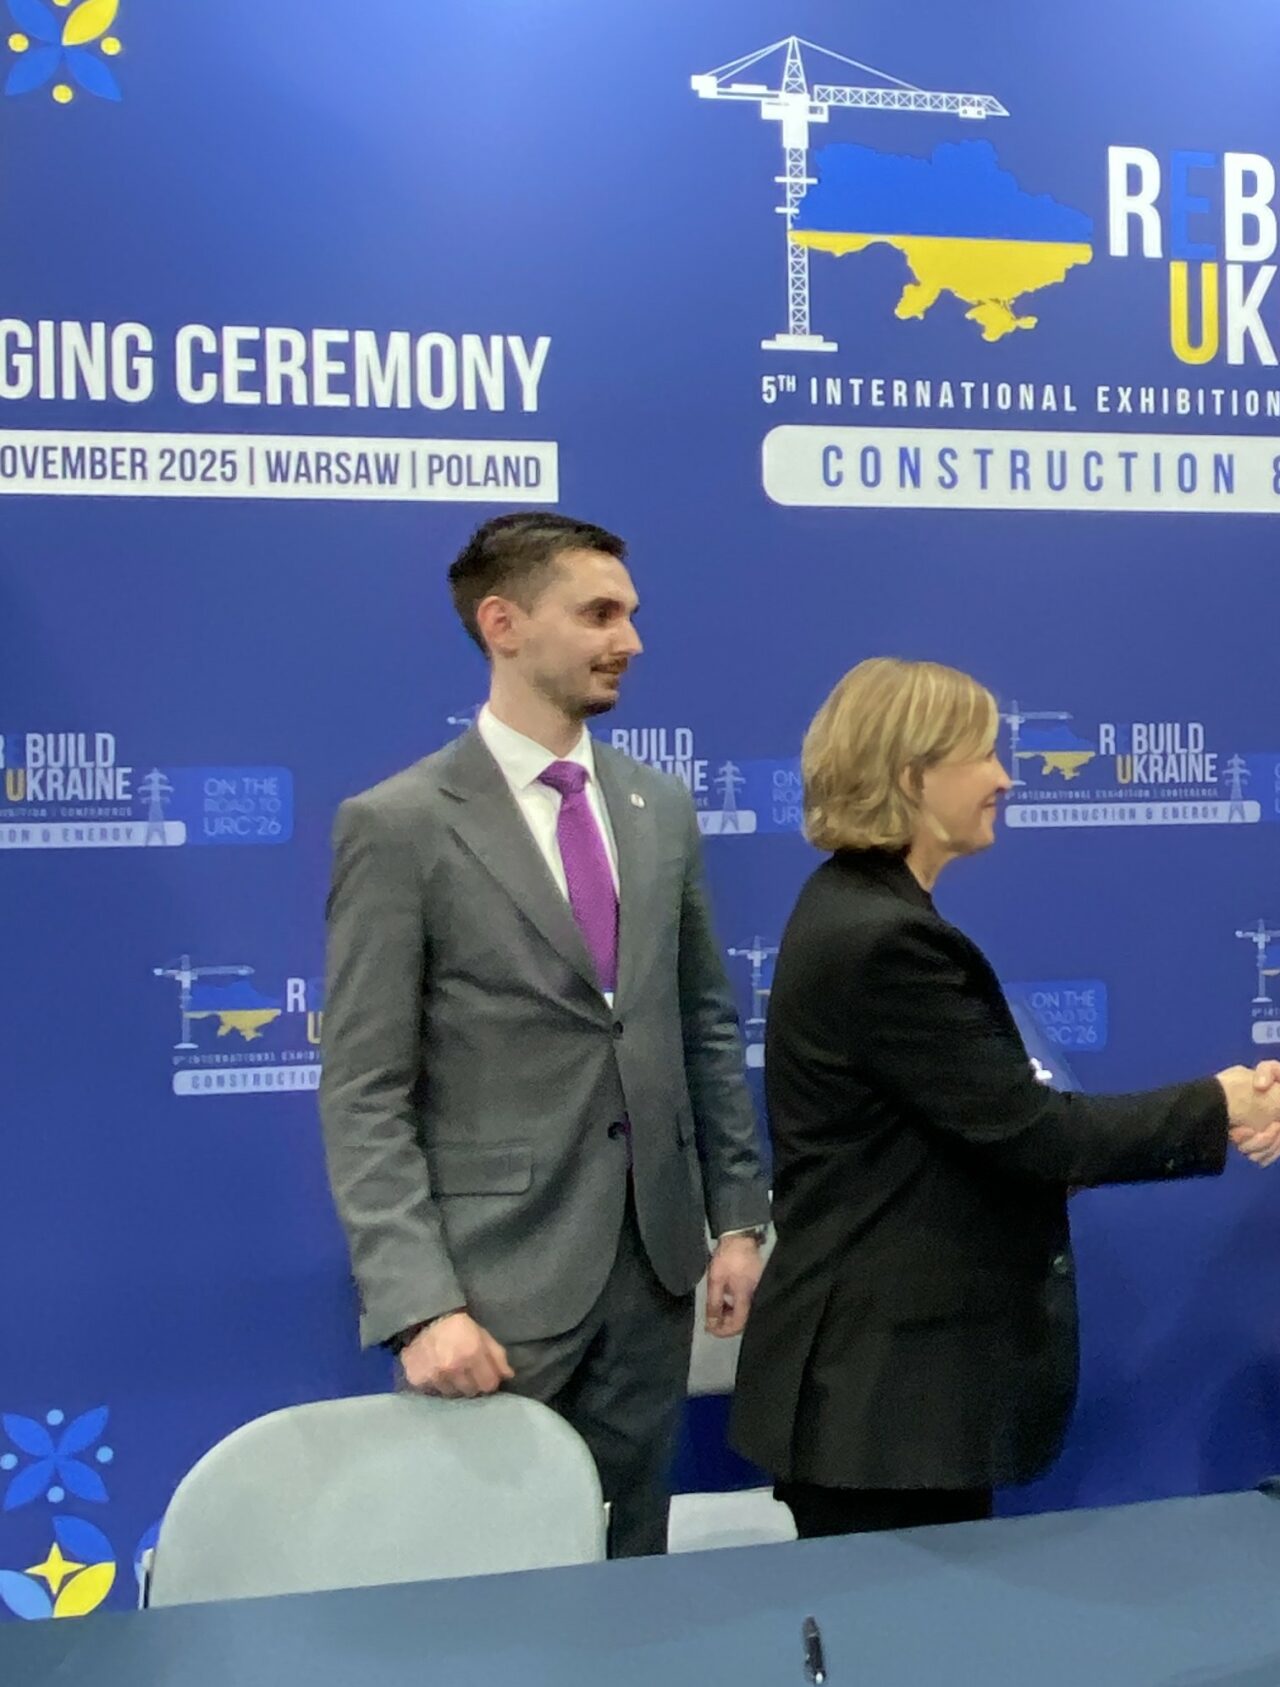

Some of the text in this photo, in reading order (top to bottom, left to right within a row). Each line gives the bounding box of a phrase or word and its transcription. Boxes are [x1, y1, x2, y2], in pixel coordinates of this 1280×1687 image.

[175, 325, 552, 413] CEREMONY
[810, 377, 1078, 412] INTERNATIONAL
[158, 449, 238, 482] 2025
[264, 449, 401, 486] WARSAW
[428, 454, 543, 488] POLAND
[822, 444, 1236, 495] CONSTRUCTION
[0, 733, 115, 768] BUILD
[612, 728, 693, 761] BUILD
[1100, 723, 1203, 755] RBUILD
[6, 767, 132, 801] UKRAINE
[1116, 754, 1218, 784] UKRAINE
[204, 777, 277, 796] ON THE
